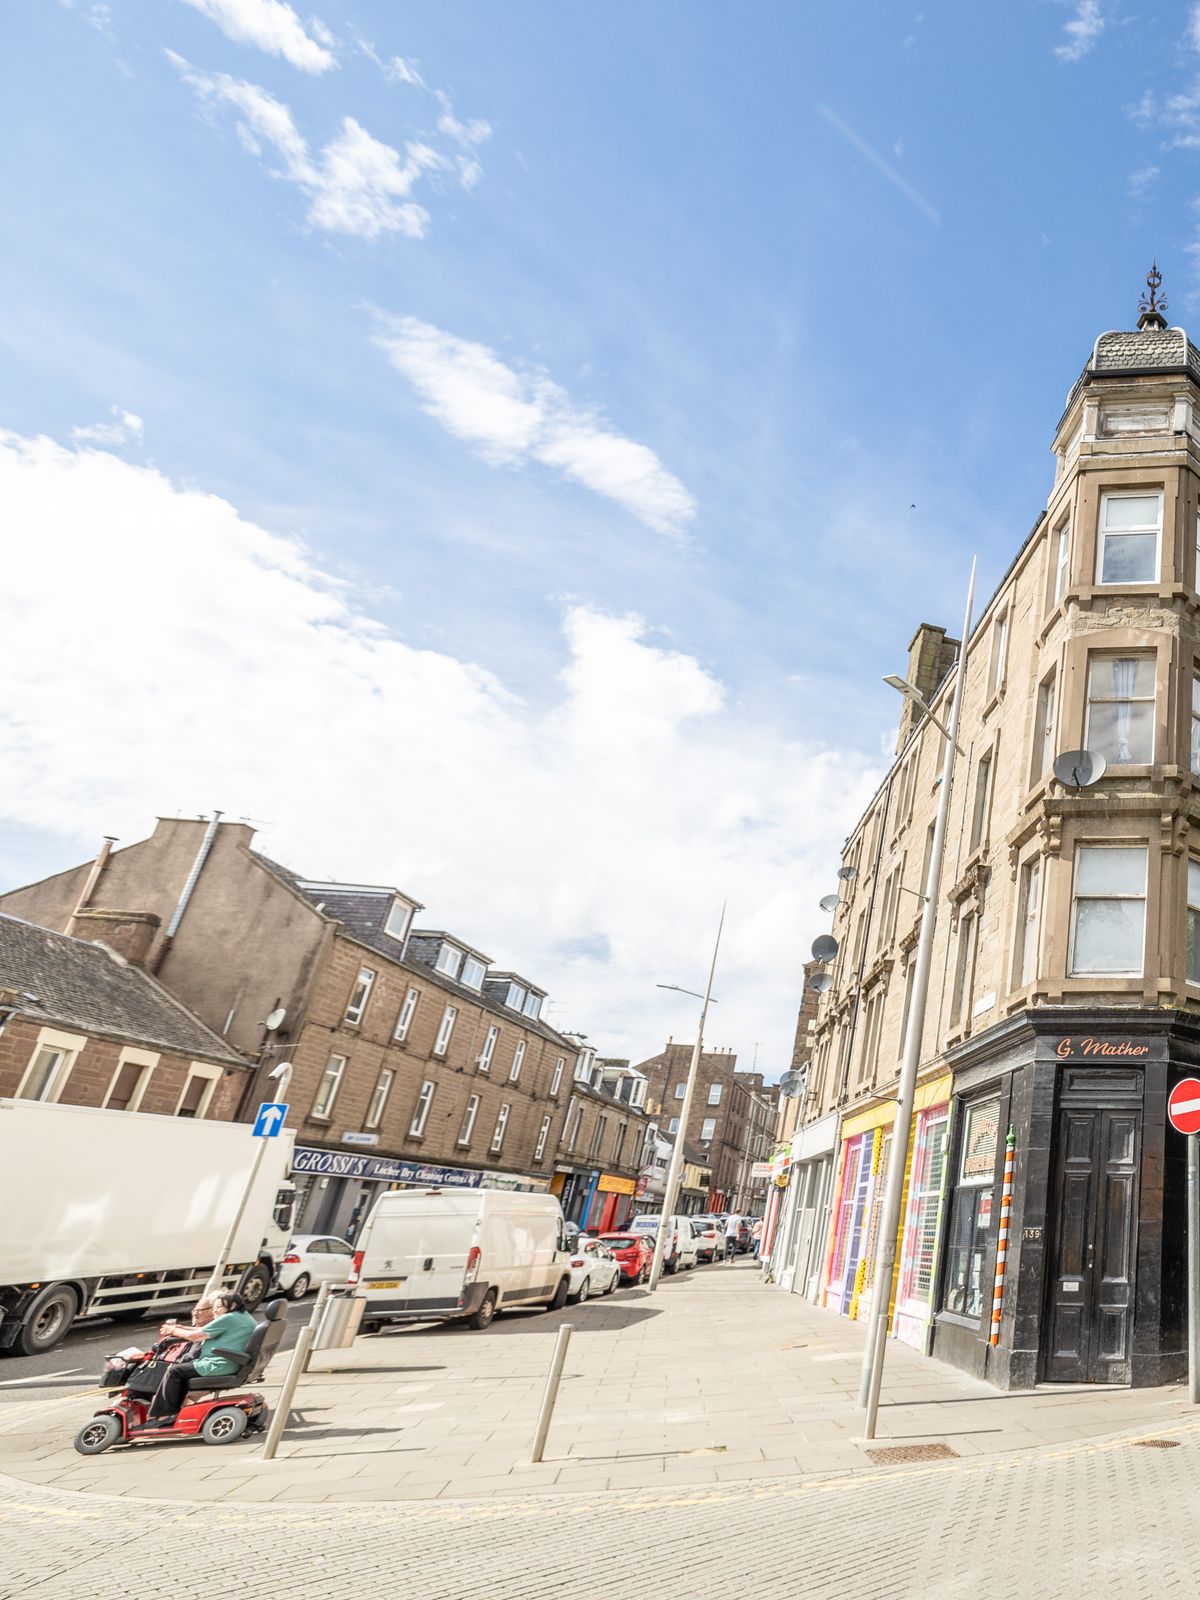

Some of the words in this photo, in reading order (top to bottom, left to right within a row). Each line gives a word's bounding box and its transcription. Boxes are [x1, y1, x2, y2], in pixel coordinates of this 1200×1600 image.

[1057, 1038, 1074, 1058] G.
[1080, 1038, 1149, 1056] Mather
[294, 1151, 368, 1175] GROSSI'S
[401, 1167, 414, 1180] Dry
[415, 1169, 444, 1183] Cleaning
[1024, 1229, 1041, 1238] 139
